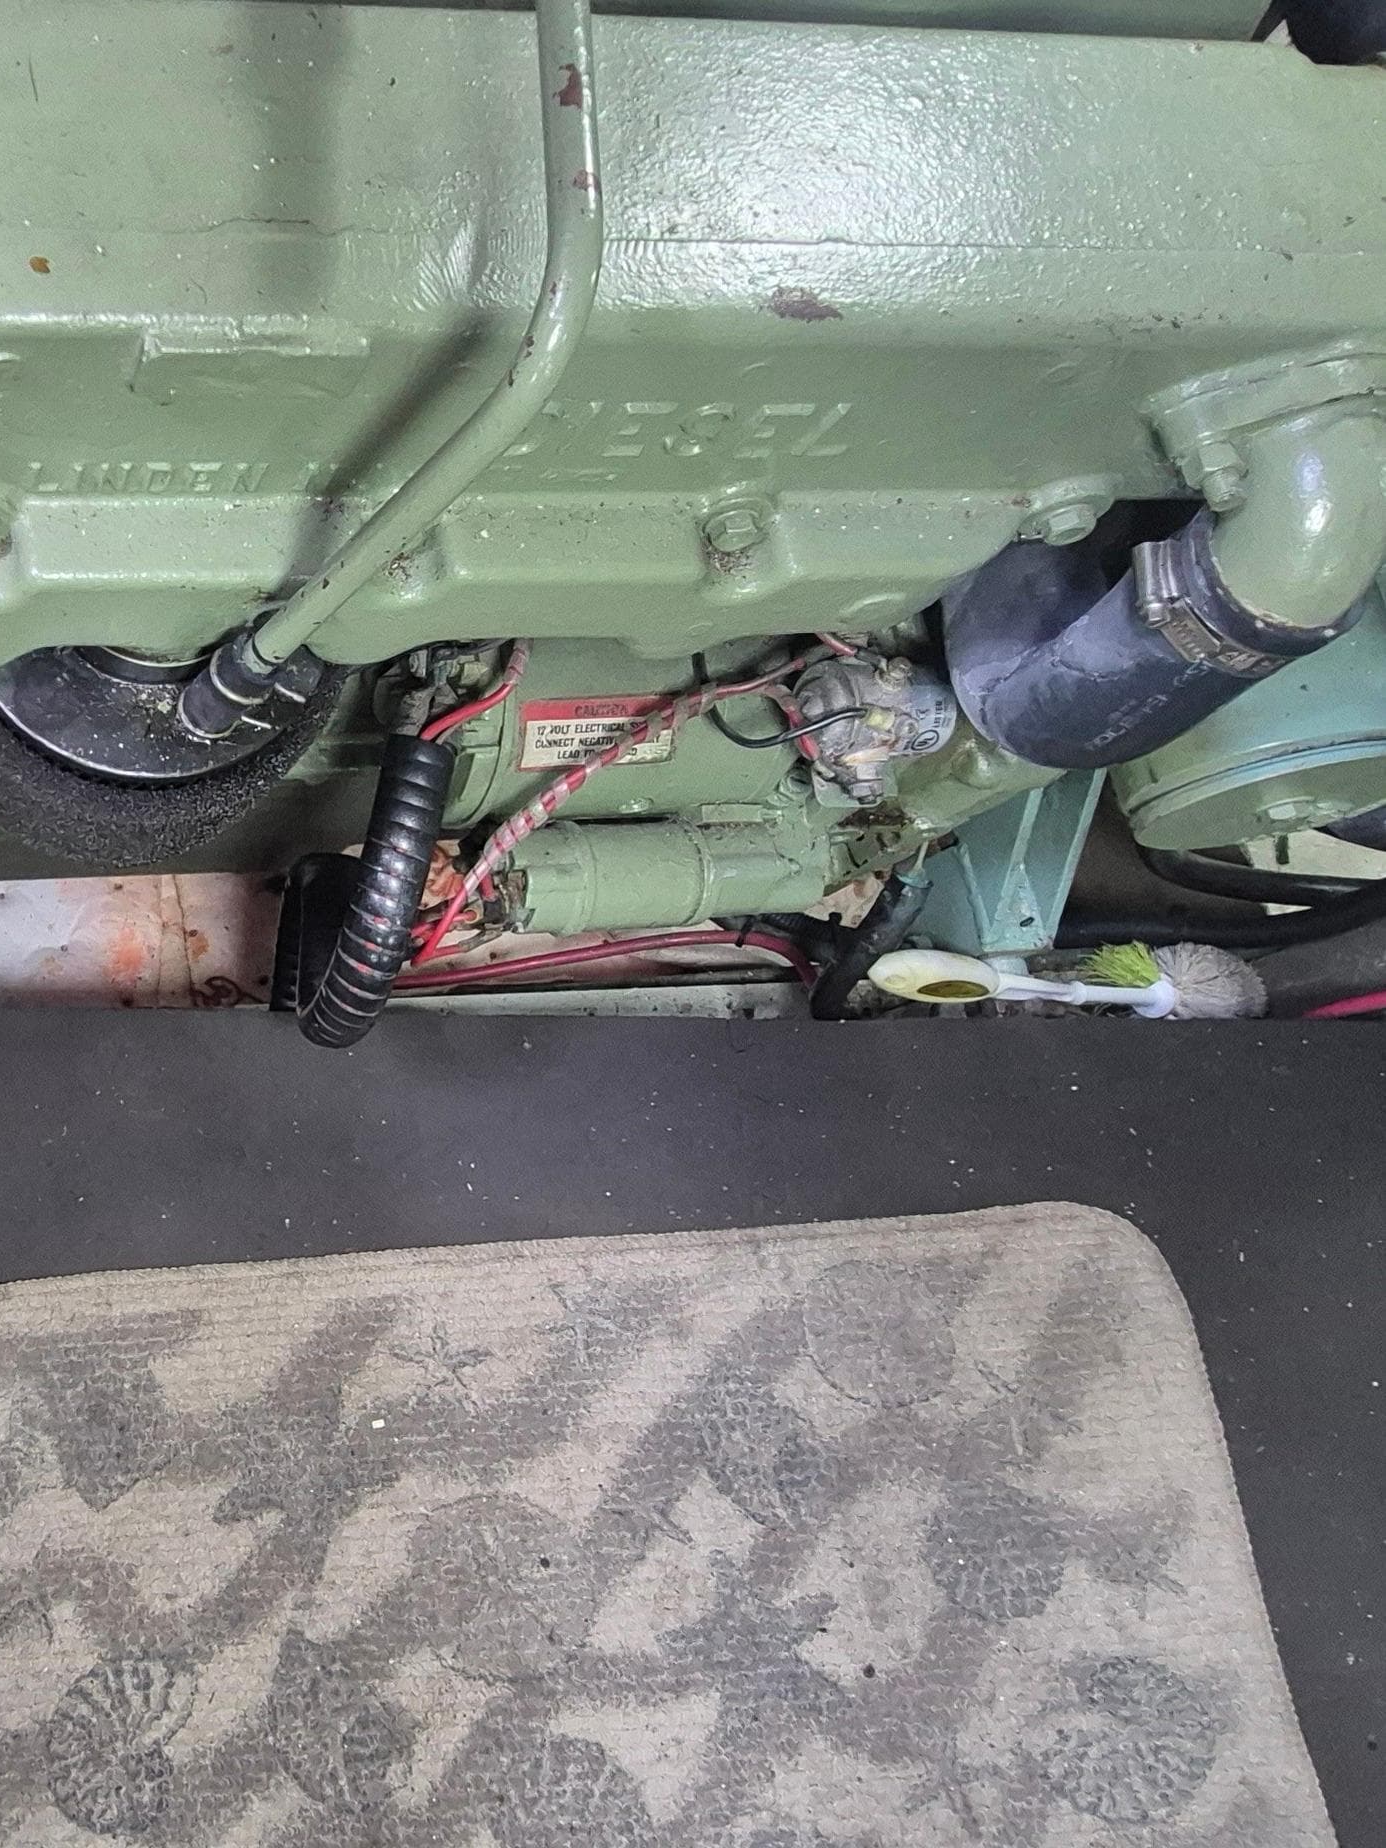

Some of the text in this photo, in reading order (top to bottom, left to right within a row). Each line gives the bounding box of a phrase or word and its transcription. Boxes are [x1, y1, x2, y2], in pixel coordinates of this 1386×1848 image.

[26, 461, 270, 493] LINDEN
[574, 721, 626, 734] ELECTRICAL
[578, 735, 616, 747] NEGATIV
[557, 750, 580, 760] LEAD
